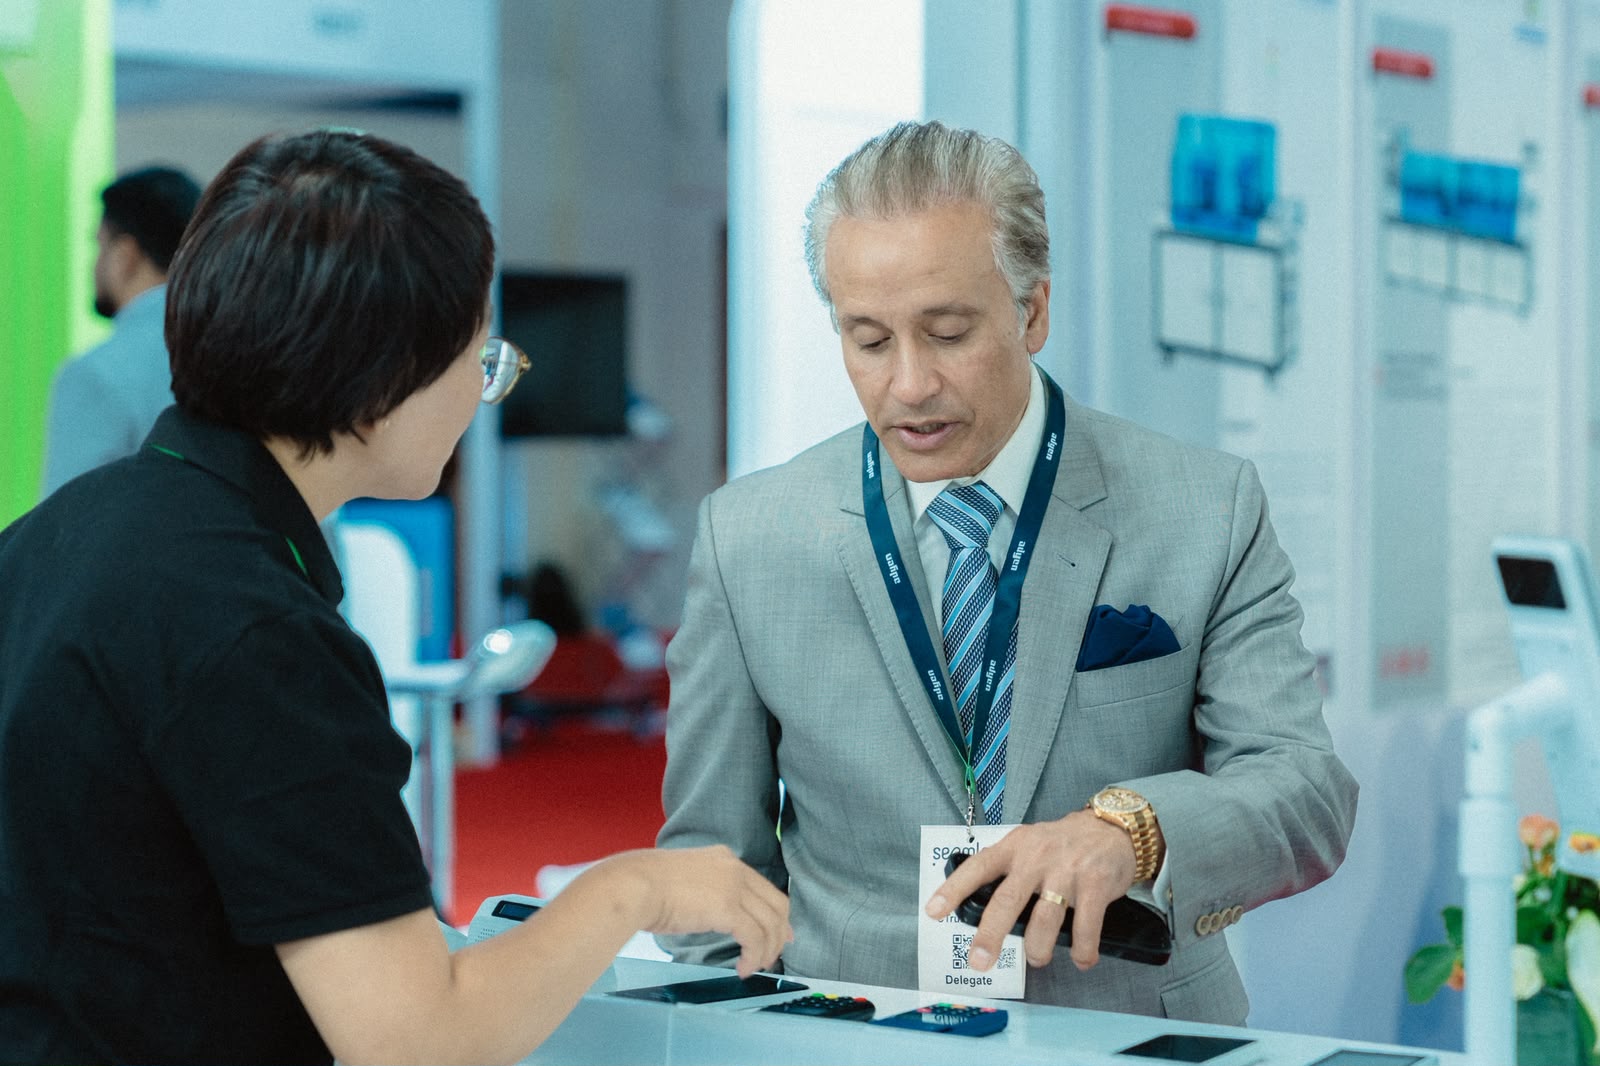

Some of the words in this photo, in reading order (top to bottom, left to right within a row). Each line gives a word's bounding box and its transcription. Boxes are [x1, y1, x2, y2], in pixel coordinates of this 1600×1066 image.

[1046, 432, 1057, 461] adyen
[867, 451, 875, 479] adyen
[885, 553, 901, 584] adyen
[1010, 540, 1026, 572] adyen
[927, 669, 944, 700] adyen
[985, 659, 997, 692] adyen
[933, 842, 979, 860] seml
[945, 975, 993, 988] Delegate
